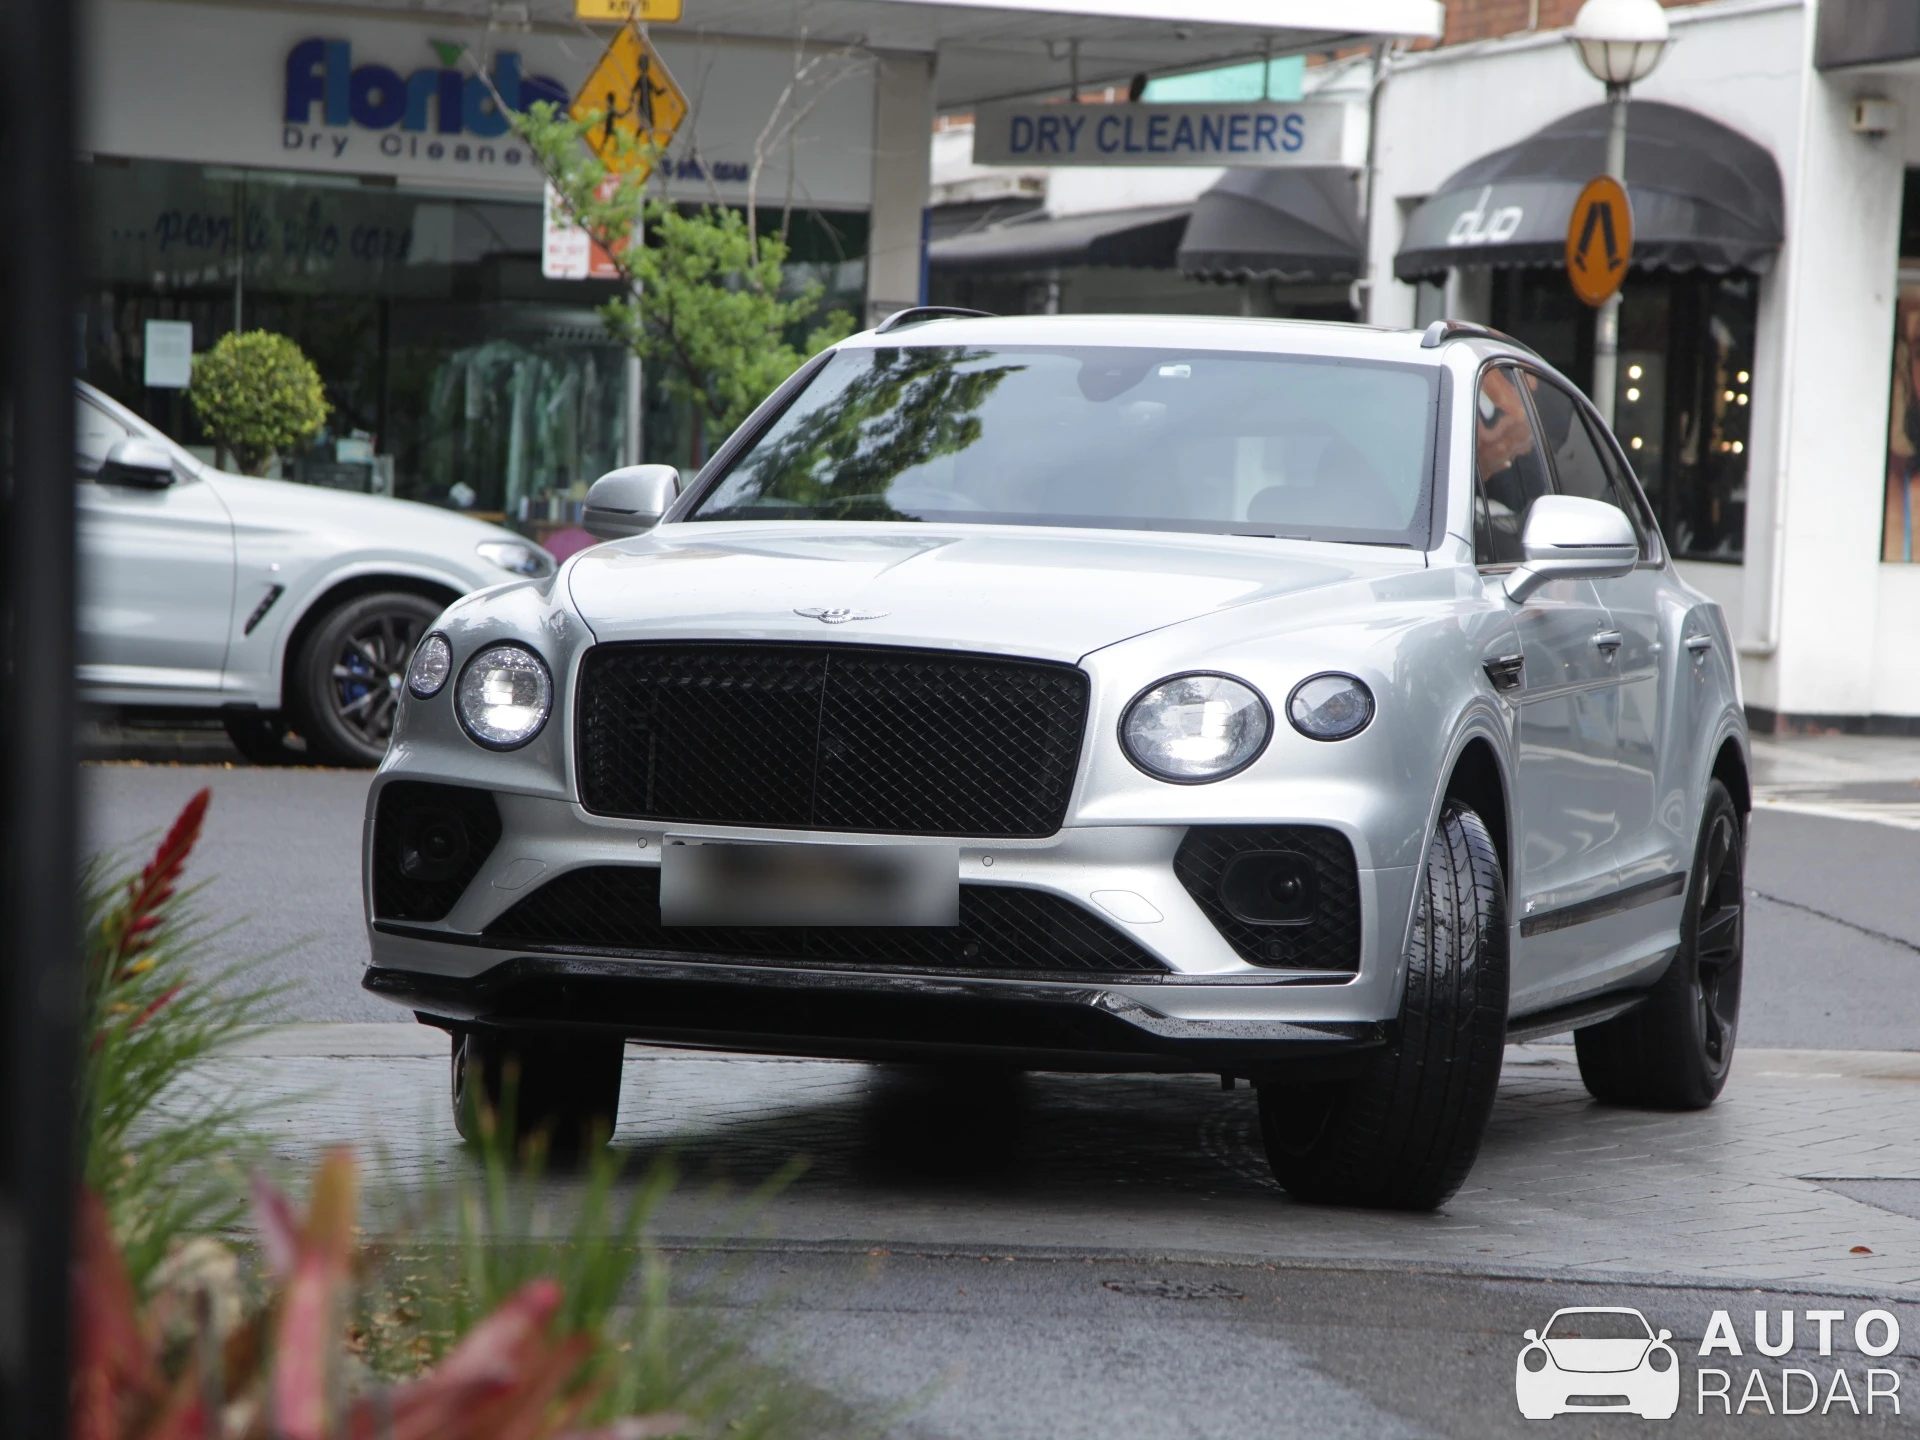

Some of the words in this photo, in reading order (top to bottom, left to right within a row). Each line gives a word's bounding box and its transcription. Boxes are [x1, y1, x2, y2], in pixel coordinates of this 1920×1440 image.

[282, 127, 349, 158] Dry
[379, 134, 550, 168] Cleaner
[1010, 115, 1085, 152] DRY
[1096, 114, 1306, 152] CLEANERS
[1446, 183, 1524, 247] duo
